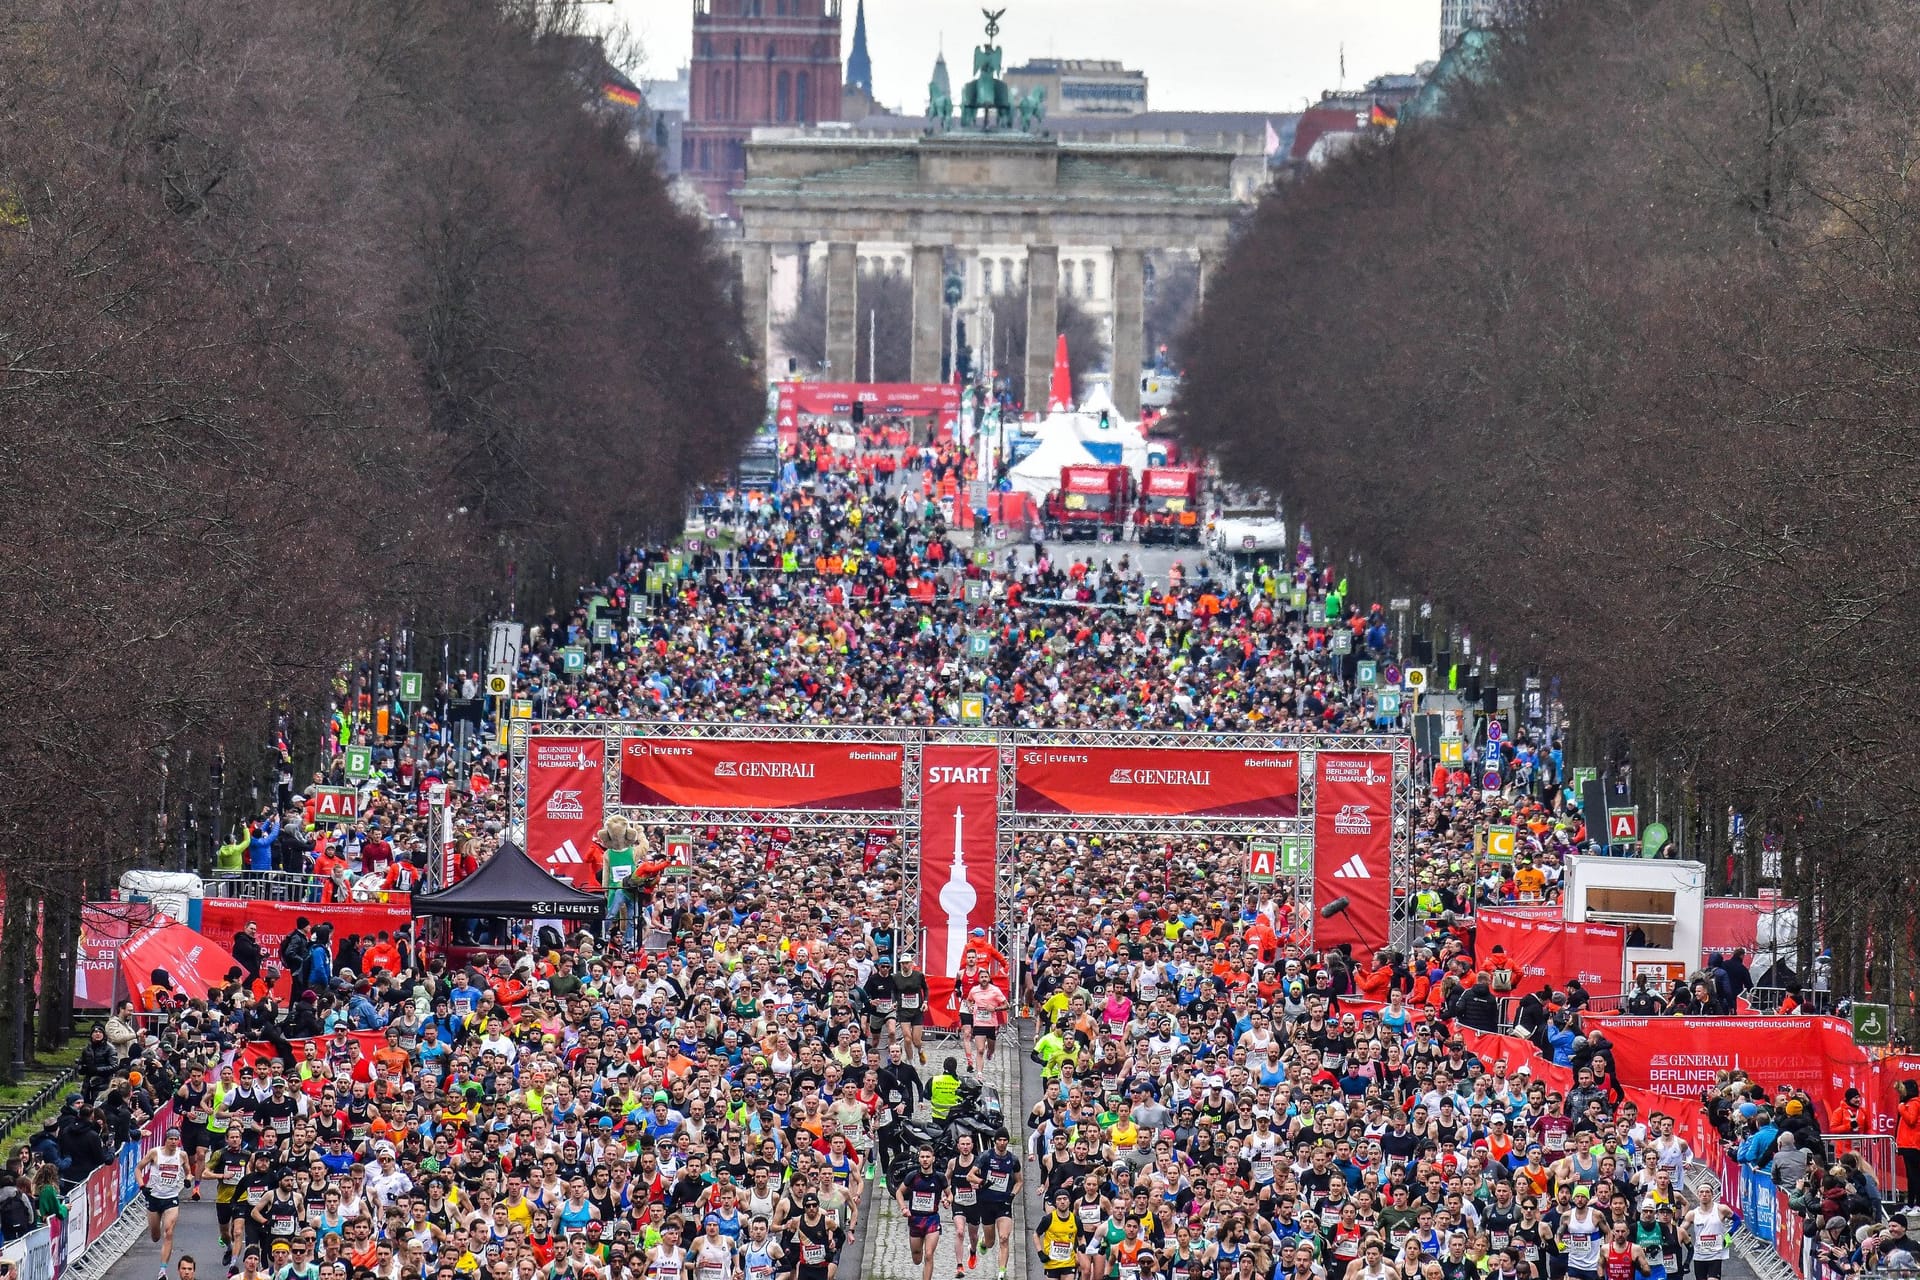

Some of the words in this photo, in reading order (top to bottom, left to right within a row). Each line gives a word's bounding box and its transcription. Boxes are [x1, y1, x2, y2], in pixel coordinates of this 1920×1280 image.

[706, 528, 716, 538] G
[672, 559, 680, 569] F
[971, 588, 980, 598] E
[634, 602, 642, 612] E
[1312, 610, 1322, 622] E
[598, 626, 606, 638] E
[974, 638, 986, 652] D
[1339, 636, 1348, 648] E
[568, 654, 580, 667] D
[1361, 668, 1372, 681] D
[966, 701, 978, 717] C
[1382, 696, 1395, 710] D
[628, 744, 647, 756] SCC
[654, 747, 693, 755] EVENTS
[849, 752, 897, 761] #berlinhalf
[1489, 744, 1496, 758] P
[351, 754, 364, 771] B
[1023, 752, 1042, 764] SCC
[1050, 755, 1088, 763] EVENTS
[1244, 759, 1293, 768] #berlinhalf
[739, 762, 815, 777] GENERALI
[929, 766, 991, 783] START
[1134, 770, 1210, 785] GENERALI
[320, 795, 336, 813] A
[342, 796, 352, 815] A
[1615, 817, 1632, 836] A
[869, 836, 887, 846] 1:25
[1494, 834, 1508, 854] C
[671, 846, 685, 865] A
[1254, 854, 1270, 873] A
[531, 902, 551, 914] SCC
[559, 905, 599, 913] EVENTS
[1684, 1020, 1811, 1029] #generalibewegtdeutschland
[1670, 1054, 1728, 1067] GENERALI
[1650, 1070, 1715, 1081] BERLINER
